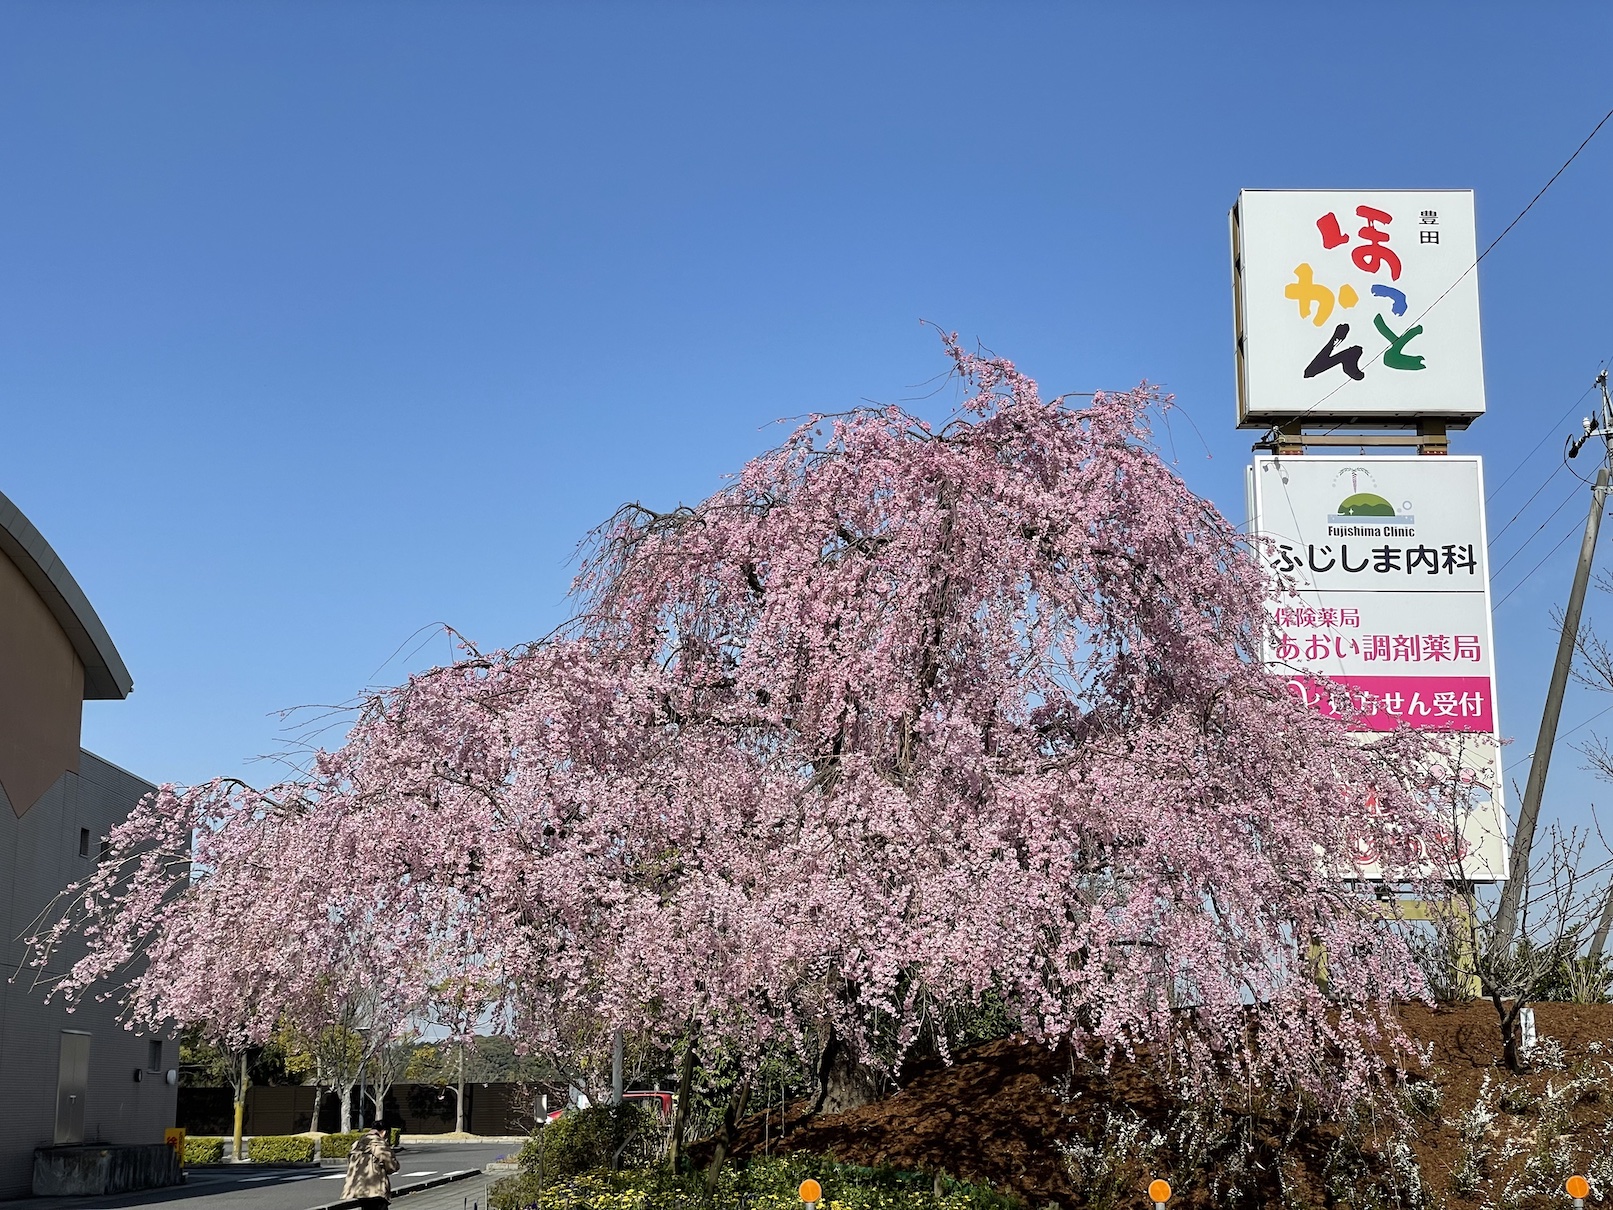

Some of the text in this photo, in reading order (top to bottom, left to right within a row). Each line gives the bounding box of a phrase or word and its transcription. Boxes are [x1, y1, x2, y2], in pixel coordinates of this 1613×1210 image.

[1418, 210, 1440, 245] 豊田
[1328, 525, 1415, 538] Fujishima Clinic
[1269, 544, 1478, 575] ふじしま内科
[1274, 607, 1360, 628] 保険薬局
[1275, 633, 1482, 662] あおい調剤薬局
